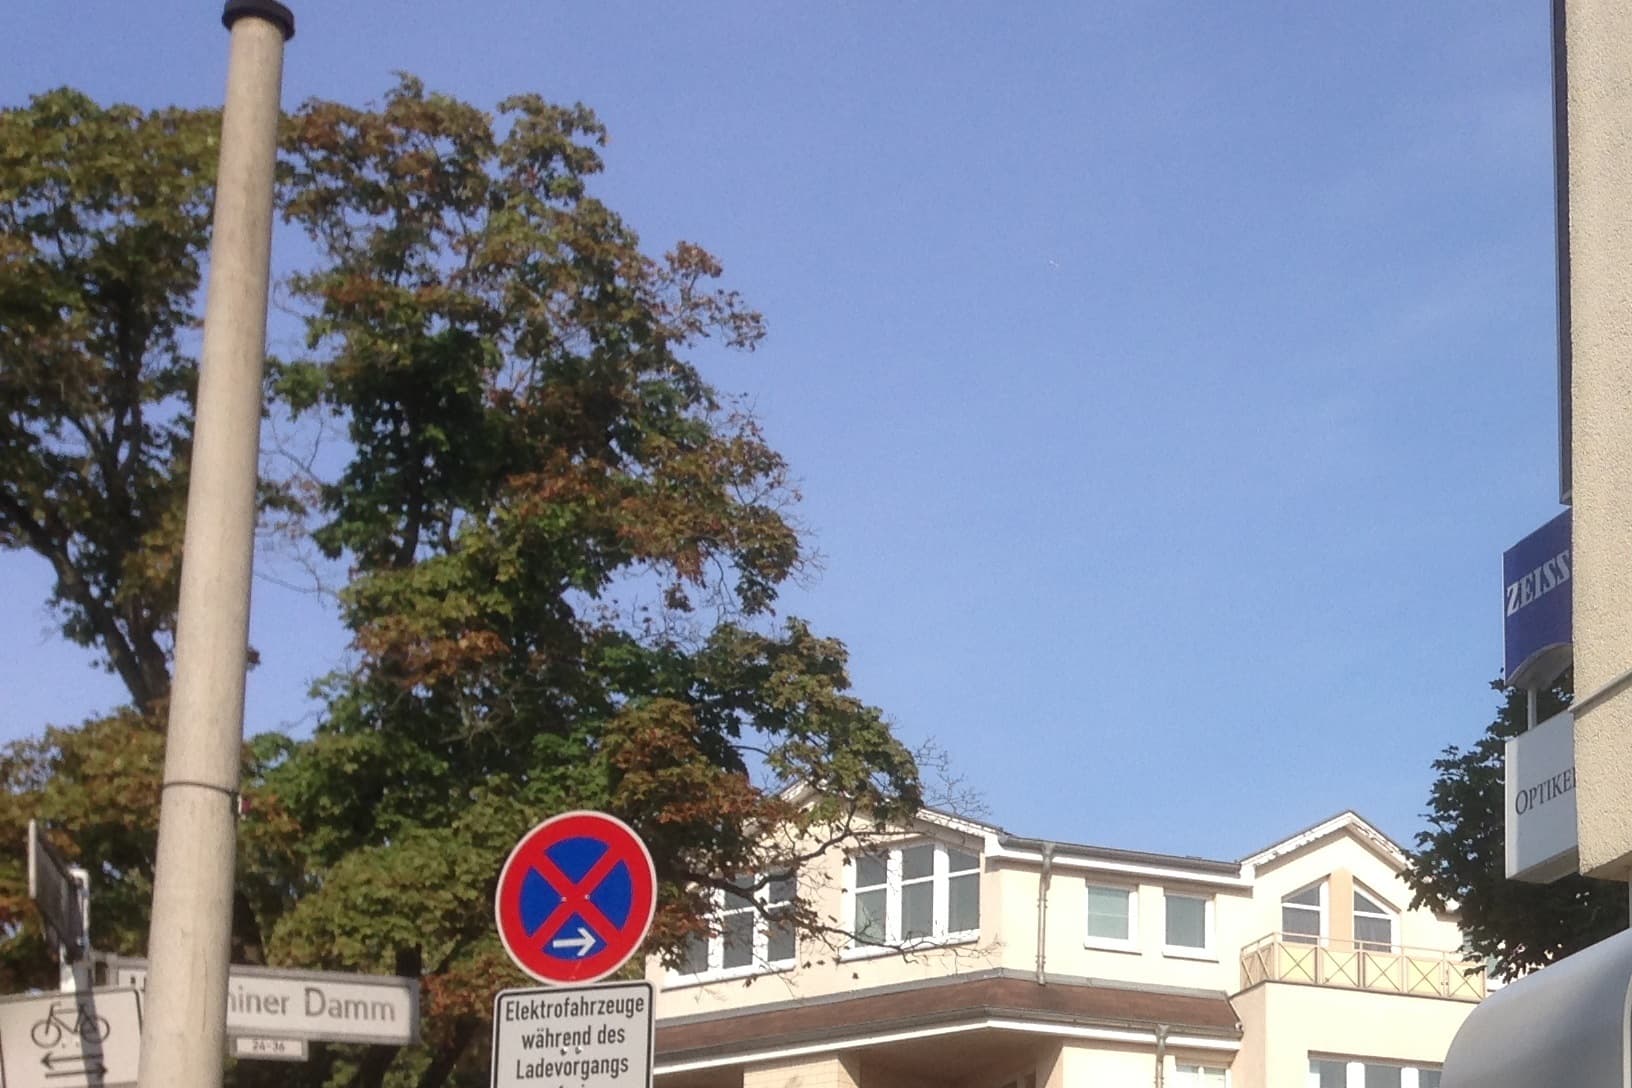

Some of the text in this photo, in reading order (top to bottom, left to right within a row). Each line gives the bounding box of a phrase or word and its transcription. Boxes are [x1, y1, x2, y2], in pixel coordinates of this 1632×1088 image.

[1506, 549, 1570, 617] ZEISS
[304, 986, 396, 1022] Damm
[505, 996, 645, 1022] Elektrofahrzeuge
[521, 1023, 626, 1050] während des
[516, 1056, 629, 1081] Ladevorgangs
